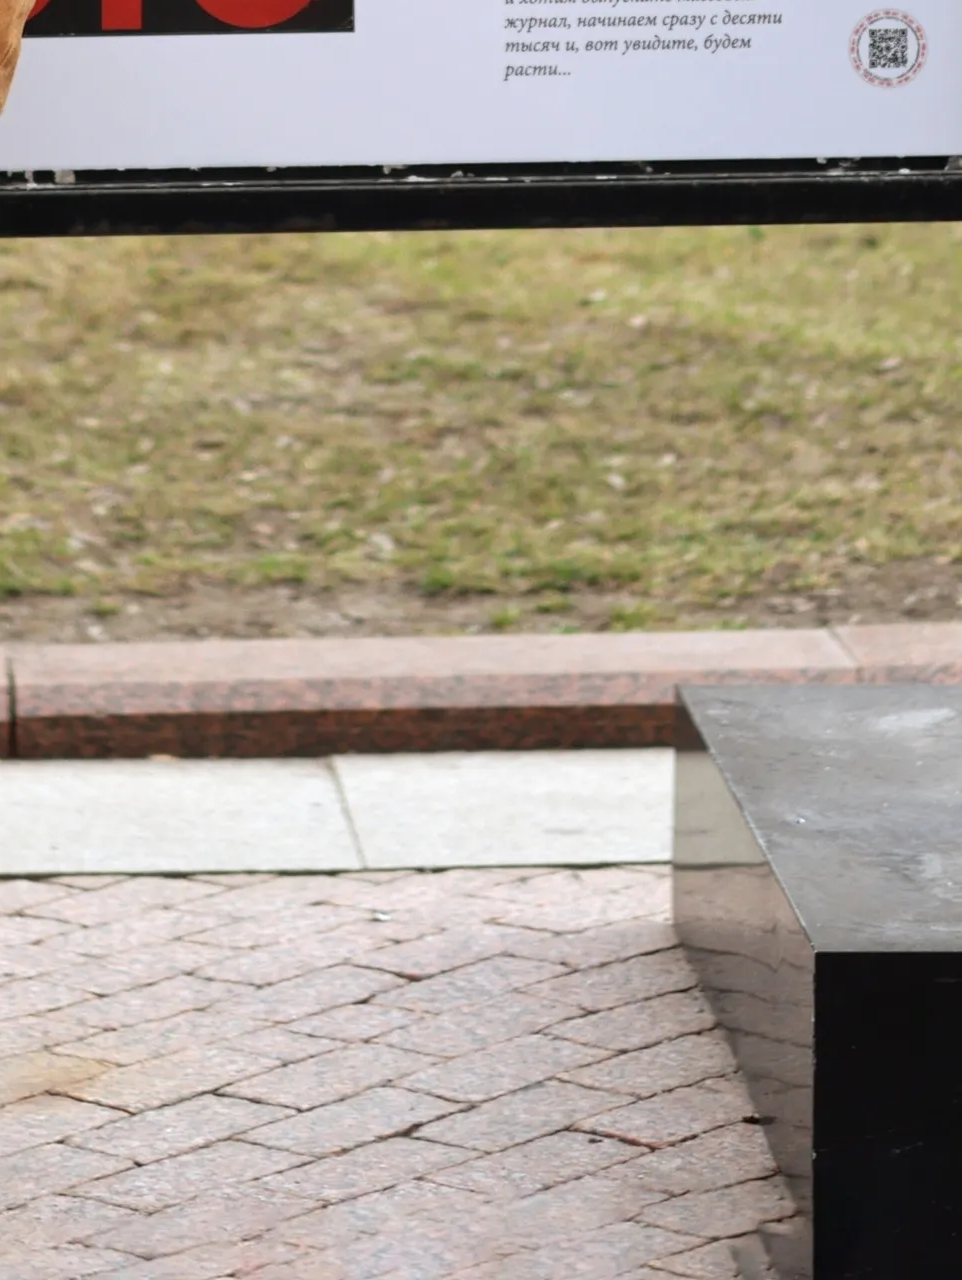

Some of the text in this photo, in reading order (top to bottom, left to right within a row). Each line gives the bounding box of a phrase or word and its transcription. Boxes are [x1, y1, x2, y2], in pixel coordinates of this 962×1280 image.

[503, 10, 783, 34] журнал, начинаем сразу с десяти
[504, 33, 752, 56] тысяч и, вот увидите, будем
